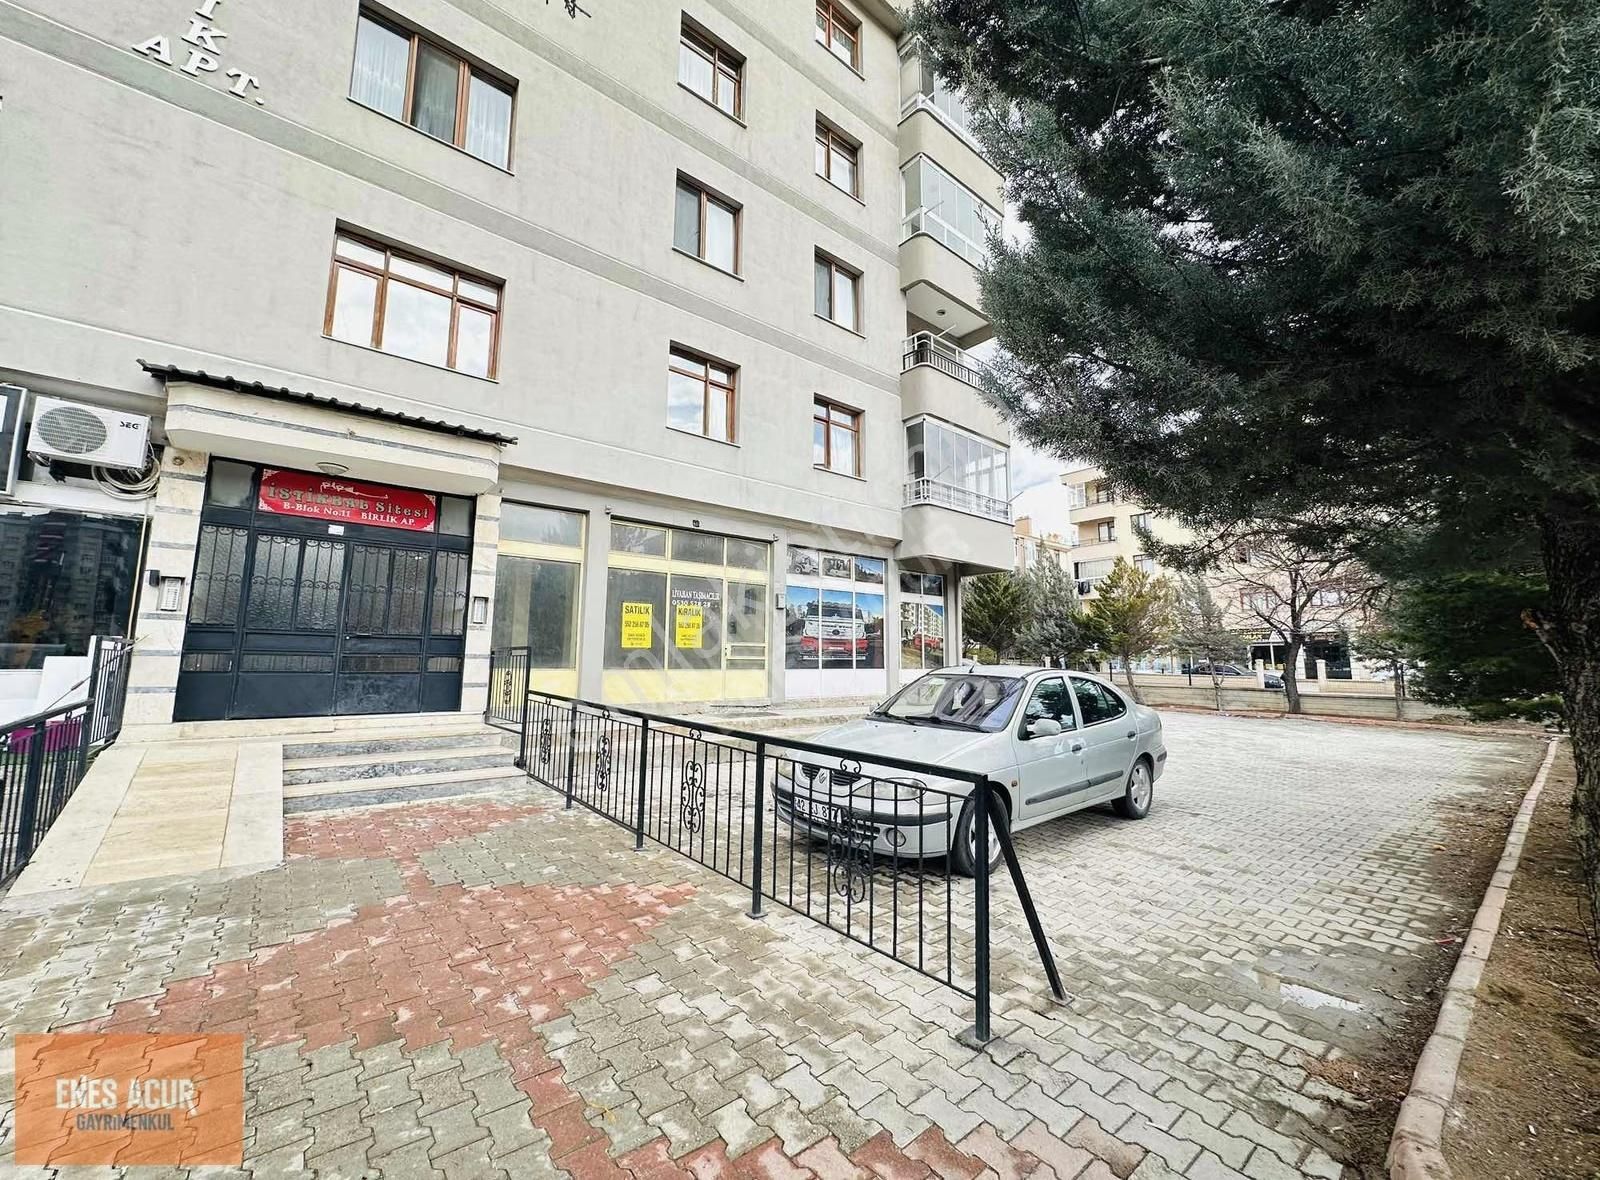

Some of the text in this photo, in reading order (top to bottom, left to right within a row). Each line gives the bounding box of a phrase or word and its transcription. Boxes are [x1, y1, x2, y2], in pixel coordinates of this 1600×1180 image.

[131, 34, 265, 106] APT.
[283, 501, 416, 526] B-Blok No.11 BİRLİK AP.
[375, 501, 428, 519] Sitesi
